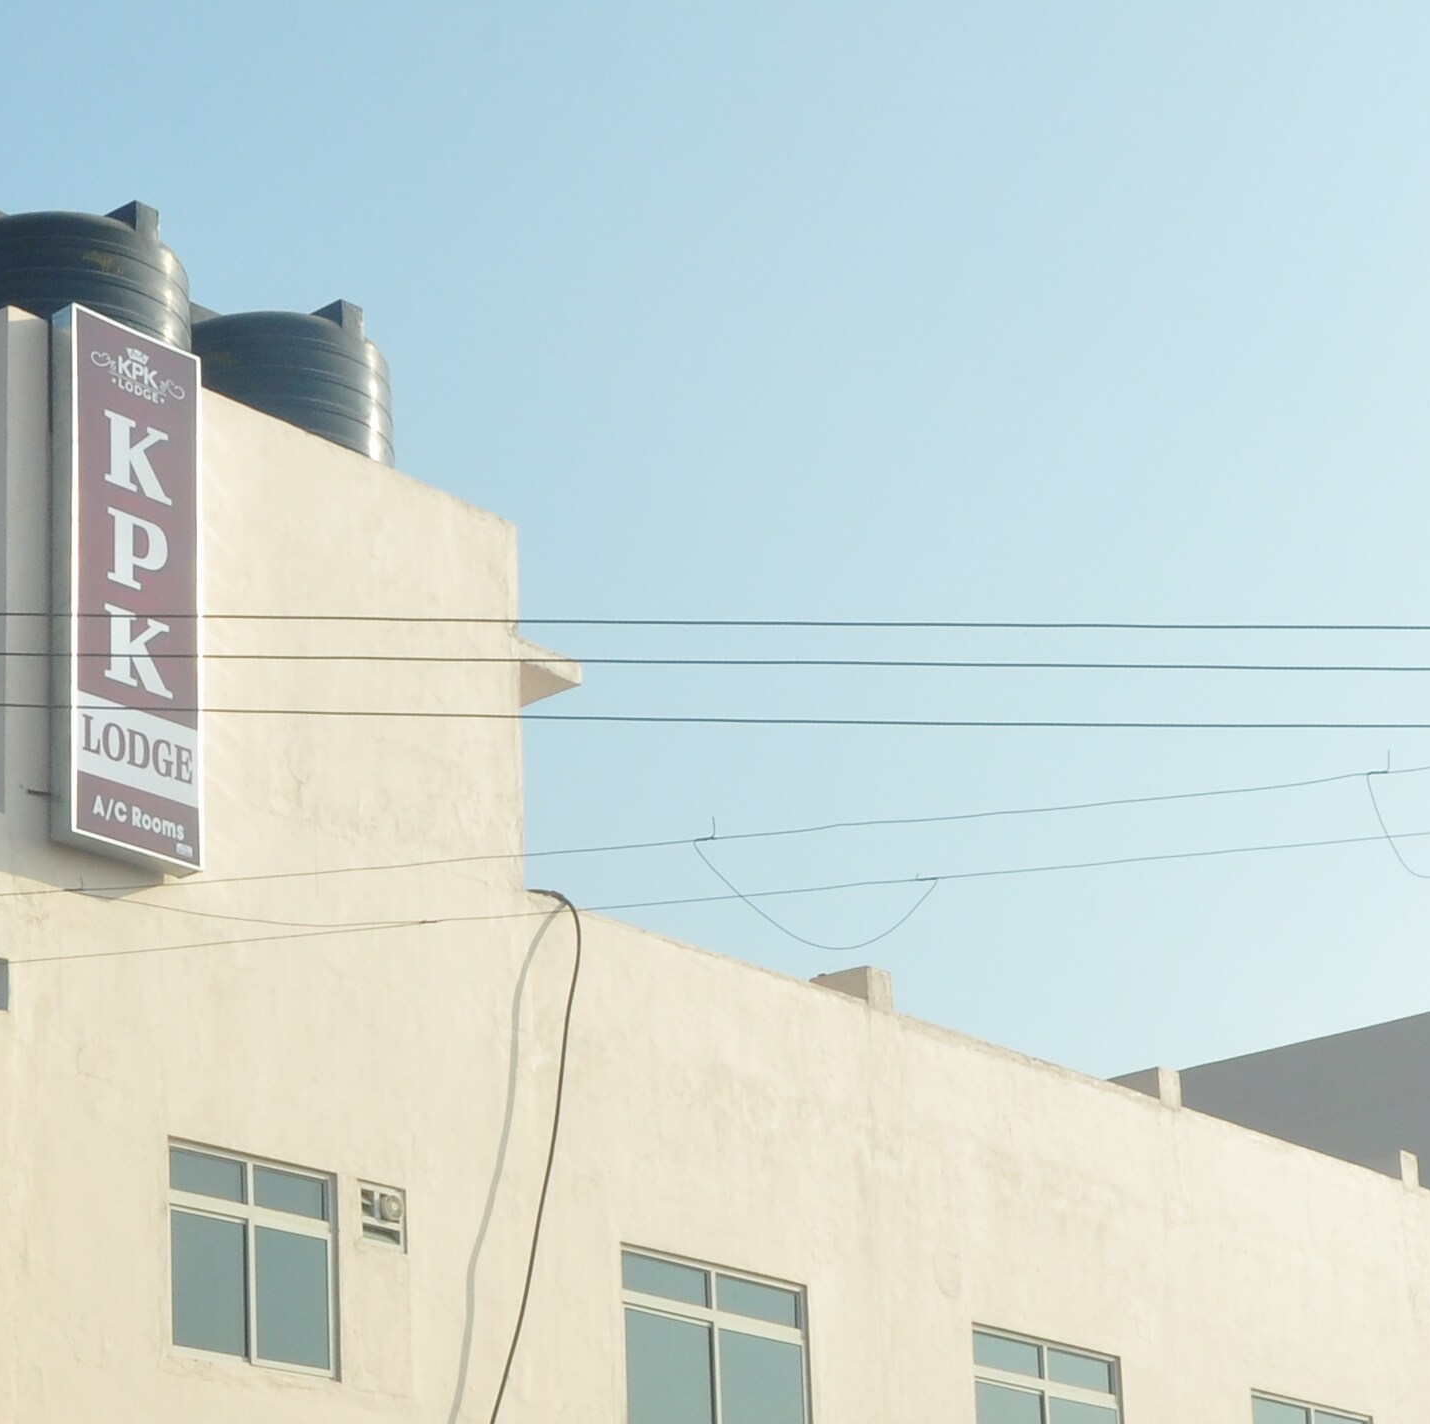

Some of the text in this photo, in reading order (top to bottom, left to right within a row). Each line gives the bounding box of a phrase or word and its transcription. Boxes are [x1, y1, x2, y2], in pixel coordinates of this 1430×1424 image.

[117, 355, 160, 391] KPK
[118, 378, 159, 404] LODGE
[82, 713, 193, 785] LODGE
[92, 795, 185, 841] A/C Rooms
